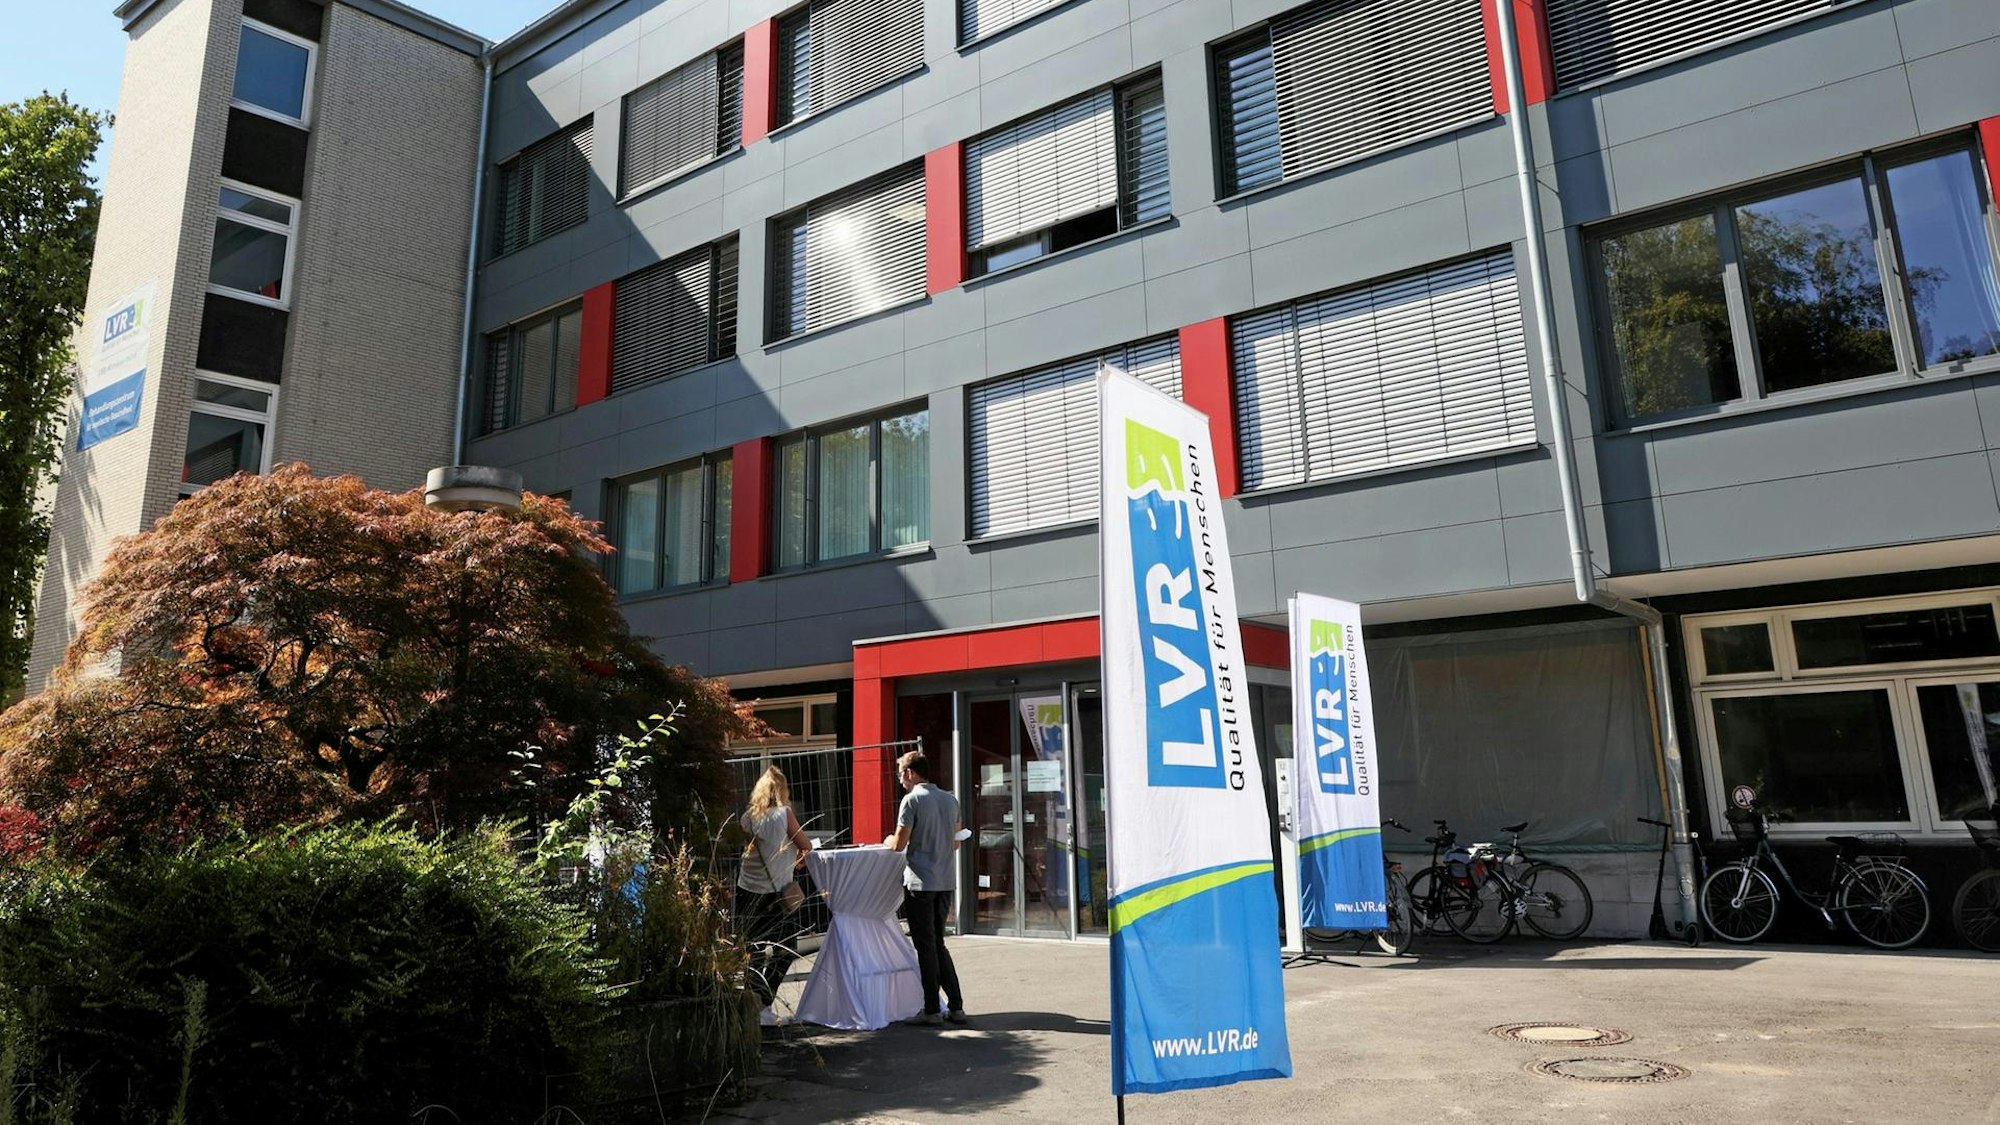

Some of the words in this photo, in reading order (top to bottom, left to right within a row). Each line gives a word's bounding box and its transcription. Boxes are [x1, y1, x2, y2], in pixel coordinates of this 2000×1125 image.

[105, 311, 128, 340] LVR
[1188, 444, 1218, 594] Menschen
[1212, 605, 1227, 651] für
[1346, 624, 1358, 701] Menschen
[1145, 562, 1217, 768] LVR
[1218, 664, 1246, 792] Qualität
[1315, 688, 1349, 786] LVR
[1352, 706, 1361, 731] für
[1354, 735, 1370, 796] Qualität
[1152, 1027, 1258, 1058] www.LVR.de
